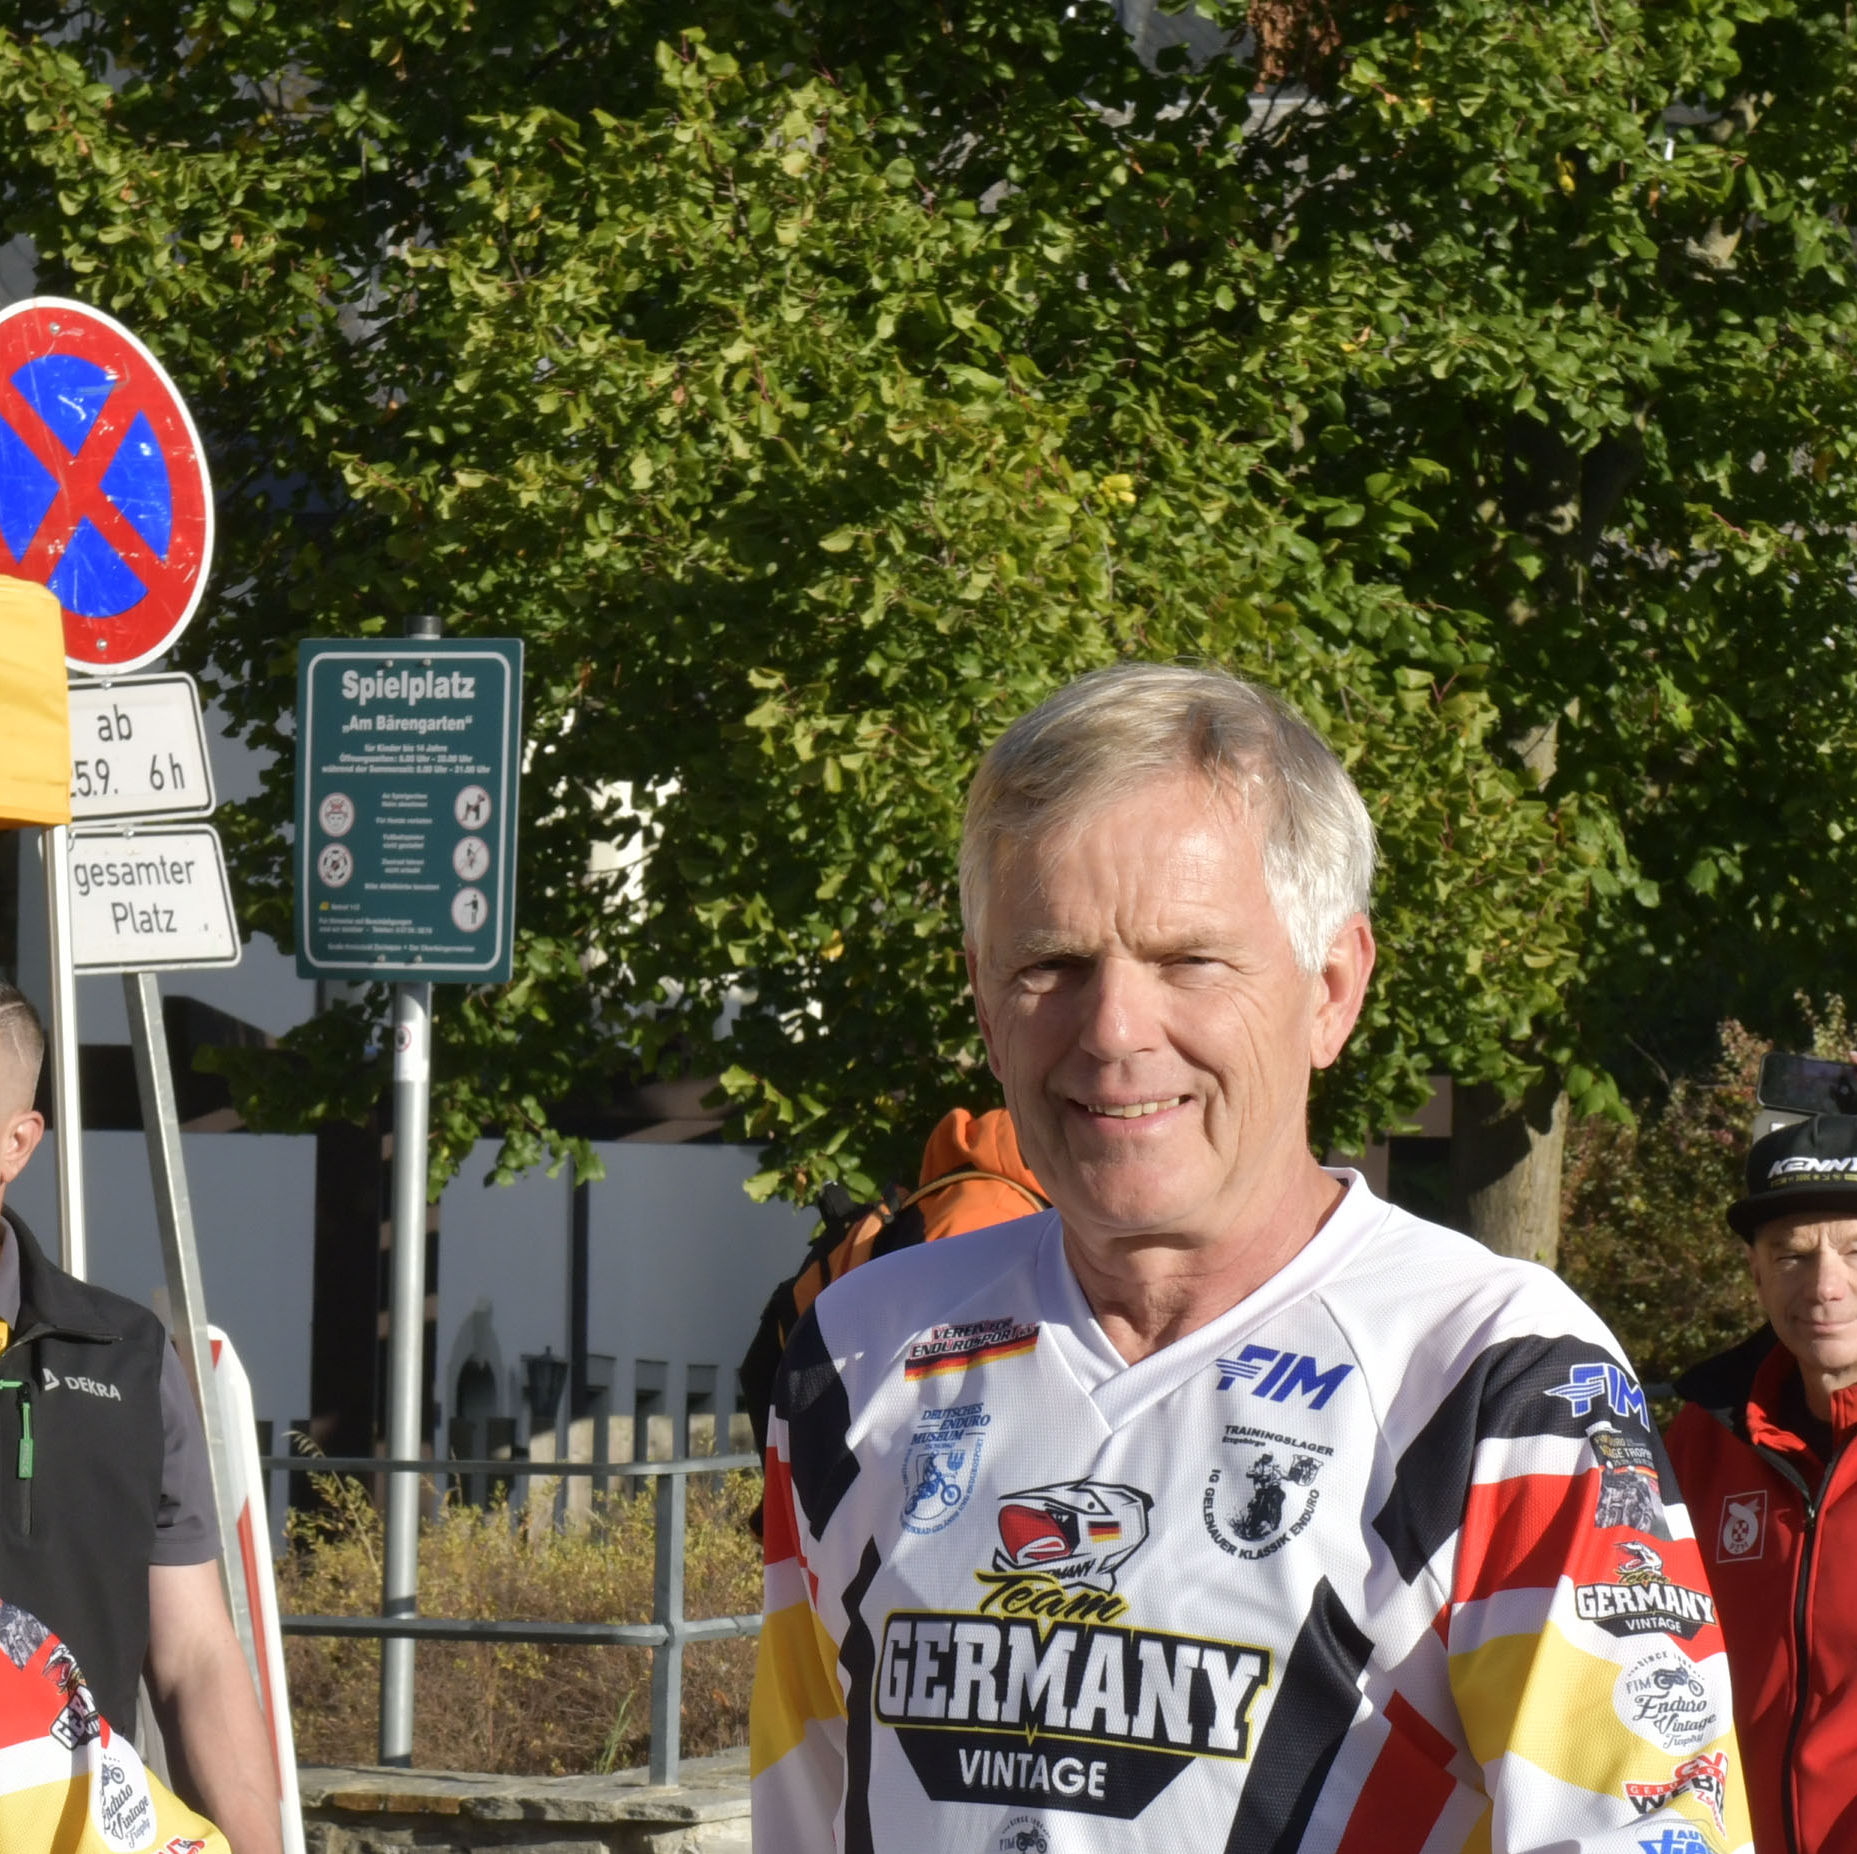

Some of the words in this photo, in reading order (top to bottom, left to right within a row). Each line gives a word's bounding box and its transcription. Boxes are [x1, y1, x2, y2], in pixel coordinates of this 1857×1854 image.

[342, 670, 476, 706] Spielplatz
[96, 703, 133, 742] ab
[70, 758, 119, 798] 5.9.
[74, 855, 195, 896] gesamter
[111, 901, 177, 934] Platz
[64, 1376, 122, 1402] DEKRA
[1216, 1343, 1354, 1411] FIM
[921, 1403, 984, 1422] DEUTSCHES
[1545, 1362, 1651, 1432] FIM
[910, 1428, 965, 1446] MUSEUM
[939, 1414, 991, 1431] ENDURO
[1224, 1424, 1335, 1457] TRAININGSLAGER
[1290, 1488, 1320, 1537] ENDURO
[976, 1570, 1128, 1621] Team
[1578, 1585, 1715, 1624] GERMANY
[1625, 1617, 1683, 1633] VINTAGE
[879, 1620, 1262, 1750] GERMANY
[1633, 1693, 1707, 1721] Enduro
[959, 1749, 1108, 1798] VINTAGE
